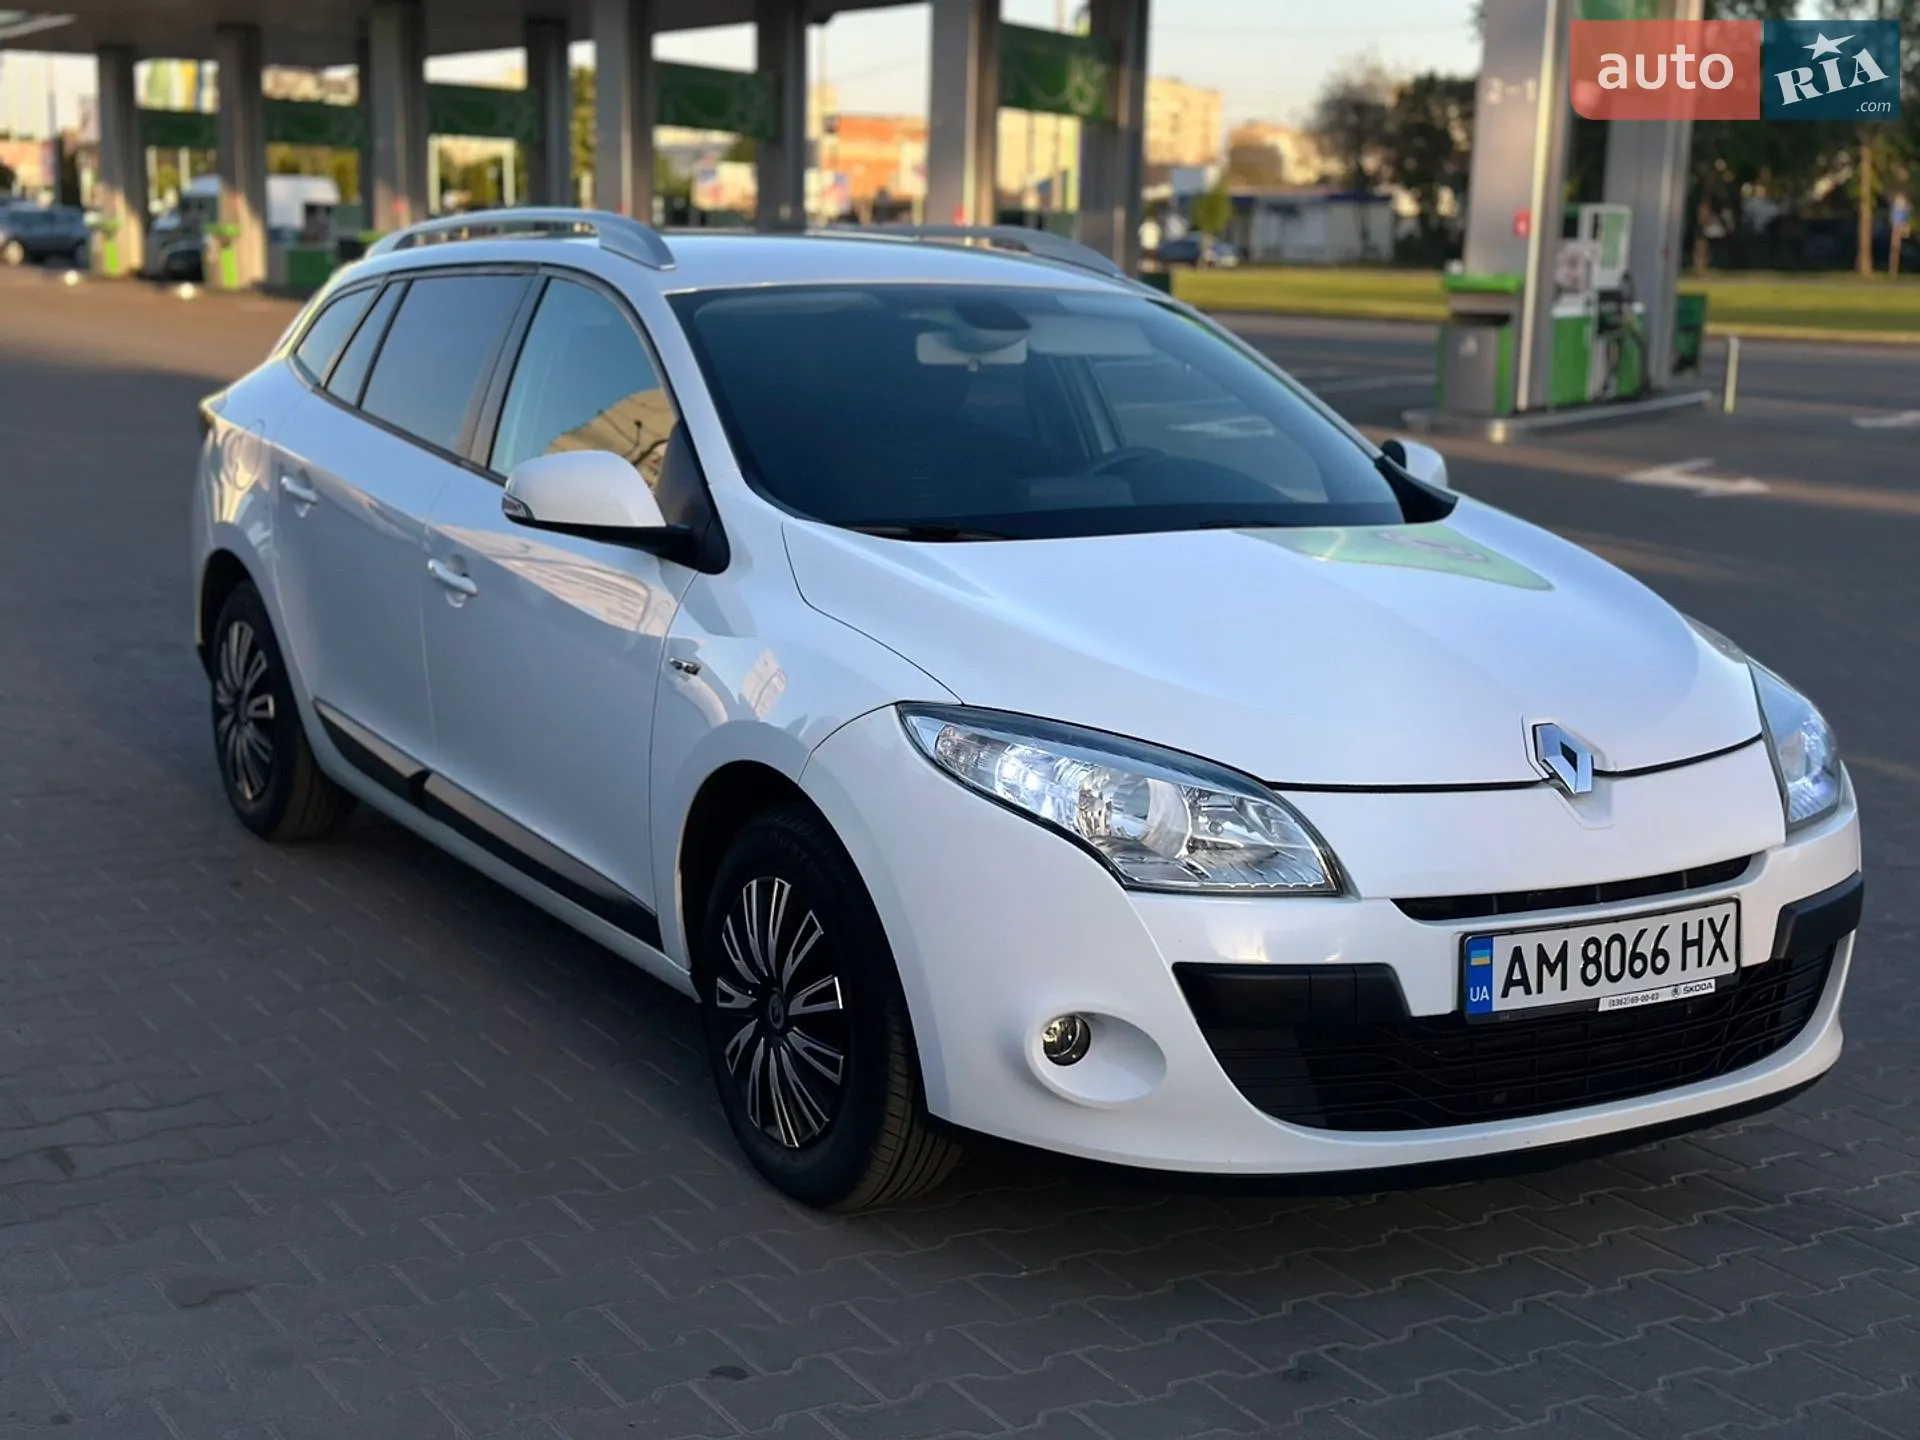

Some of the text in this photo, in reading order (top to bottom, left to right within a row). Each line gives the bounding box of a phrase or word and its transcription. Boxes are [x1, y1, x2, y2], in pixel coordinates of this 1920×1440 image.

[1501, 914, 1730, 998] AM 8066 HX
[1469, 985, 1490, 1001] UA
